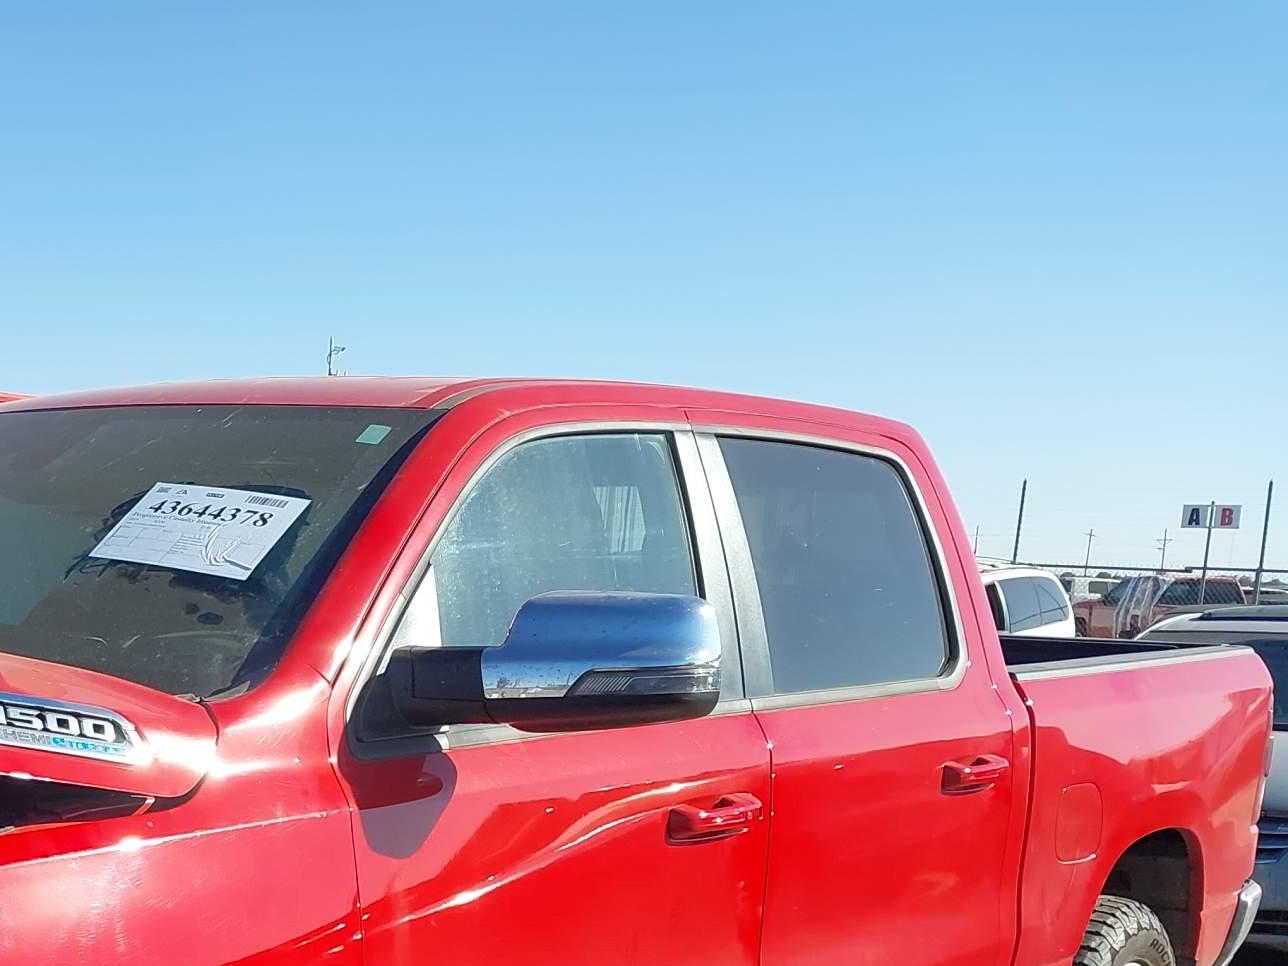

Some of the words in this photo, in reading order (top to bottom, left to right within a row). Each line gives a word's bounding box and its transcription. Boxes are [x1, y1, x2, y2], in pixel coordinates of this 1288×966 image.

[148, 500, 274, 528] 43644378
[1187, 507, 1201, 526] A
[1220, 507, 1234, 526] B
[3, 728, 51, 744] HEMI
